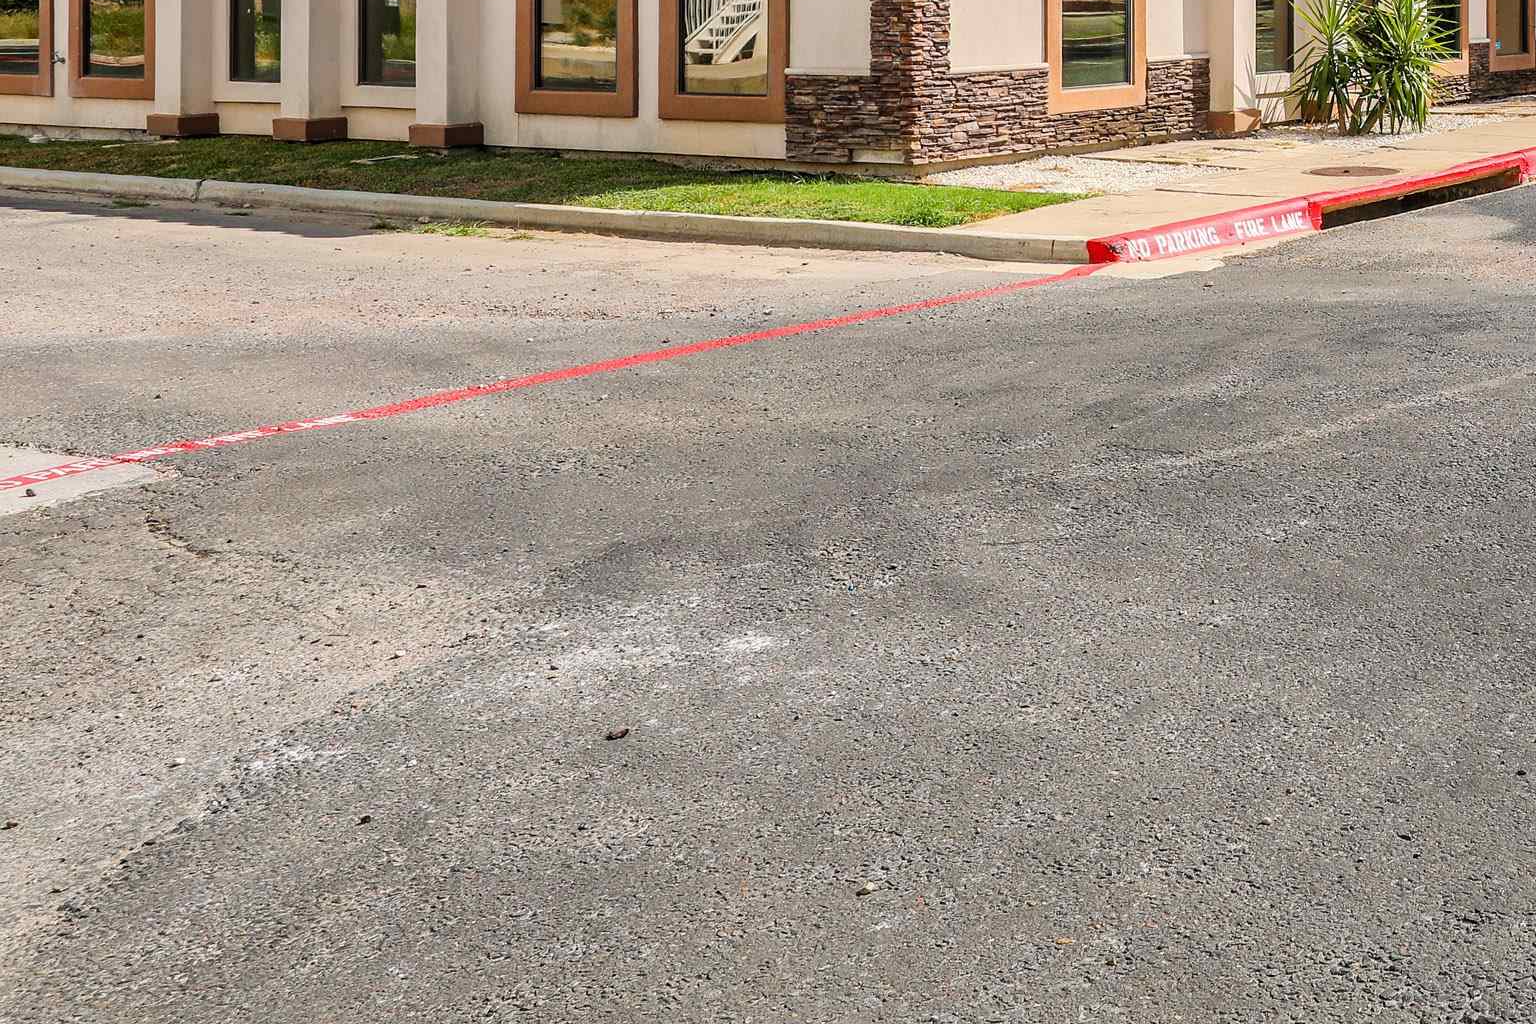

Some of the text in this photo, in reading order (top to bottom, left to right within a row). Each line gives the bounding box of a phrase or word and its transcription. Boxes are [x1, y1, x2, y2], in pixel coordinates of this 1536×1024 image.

[1127, 211, 1308, 257] NO PARKING FIRE LANE
